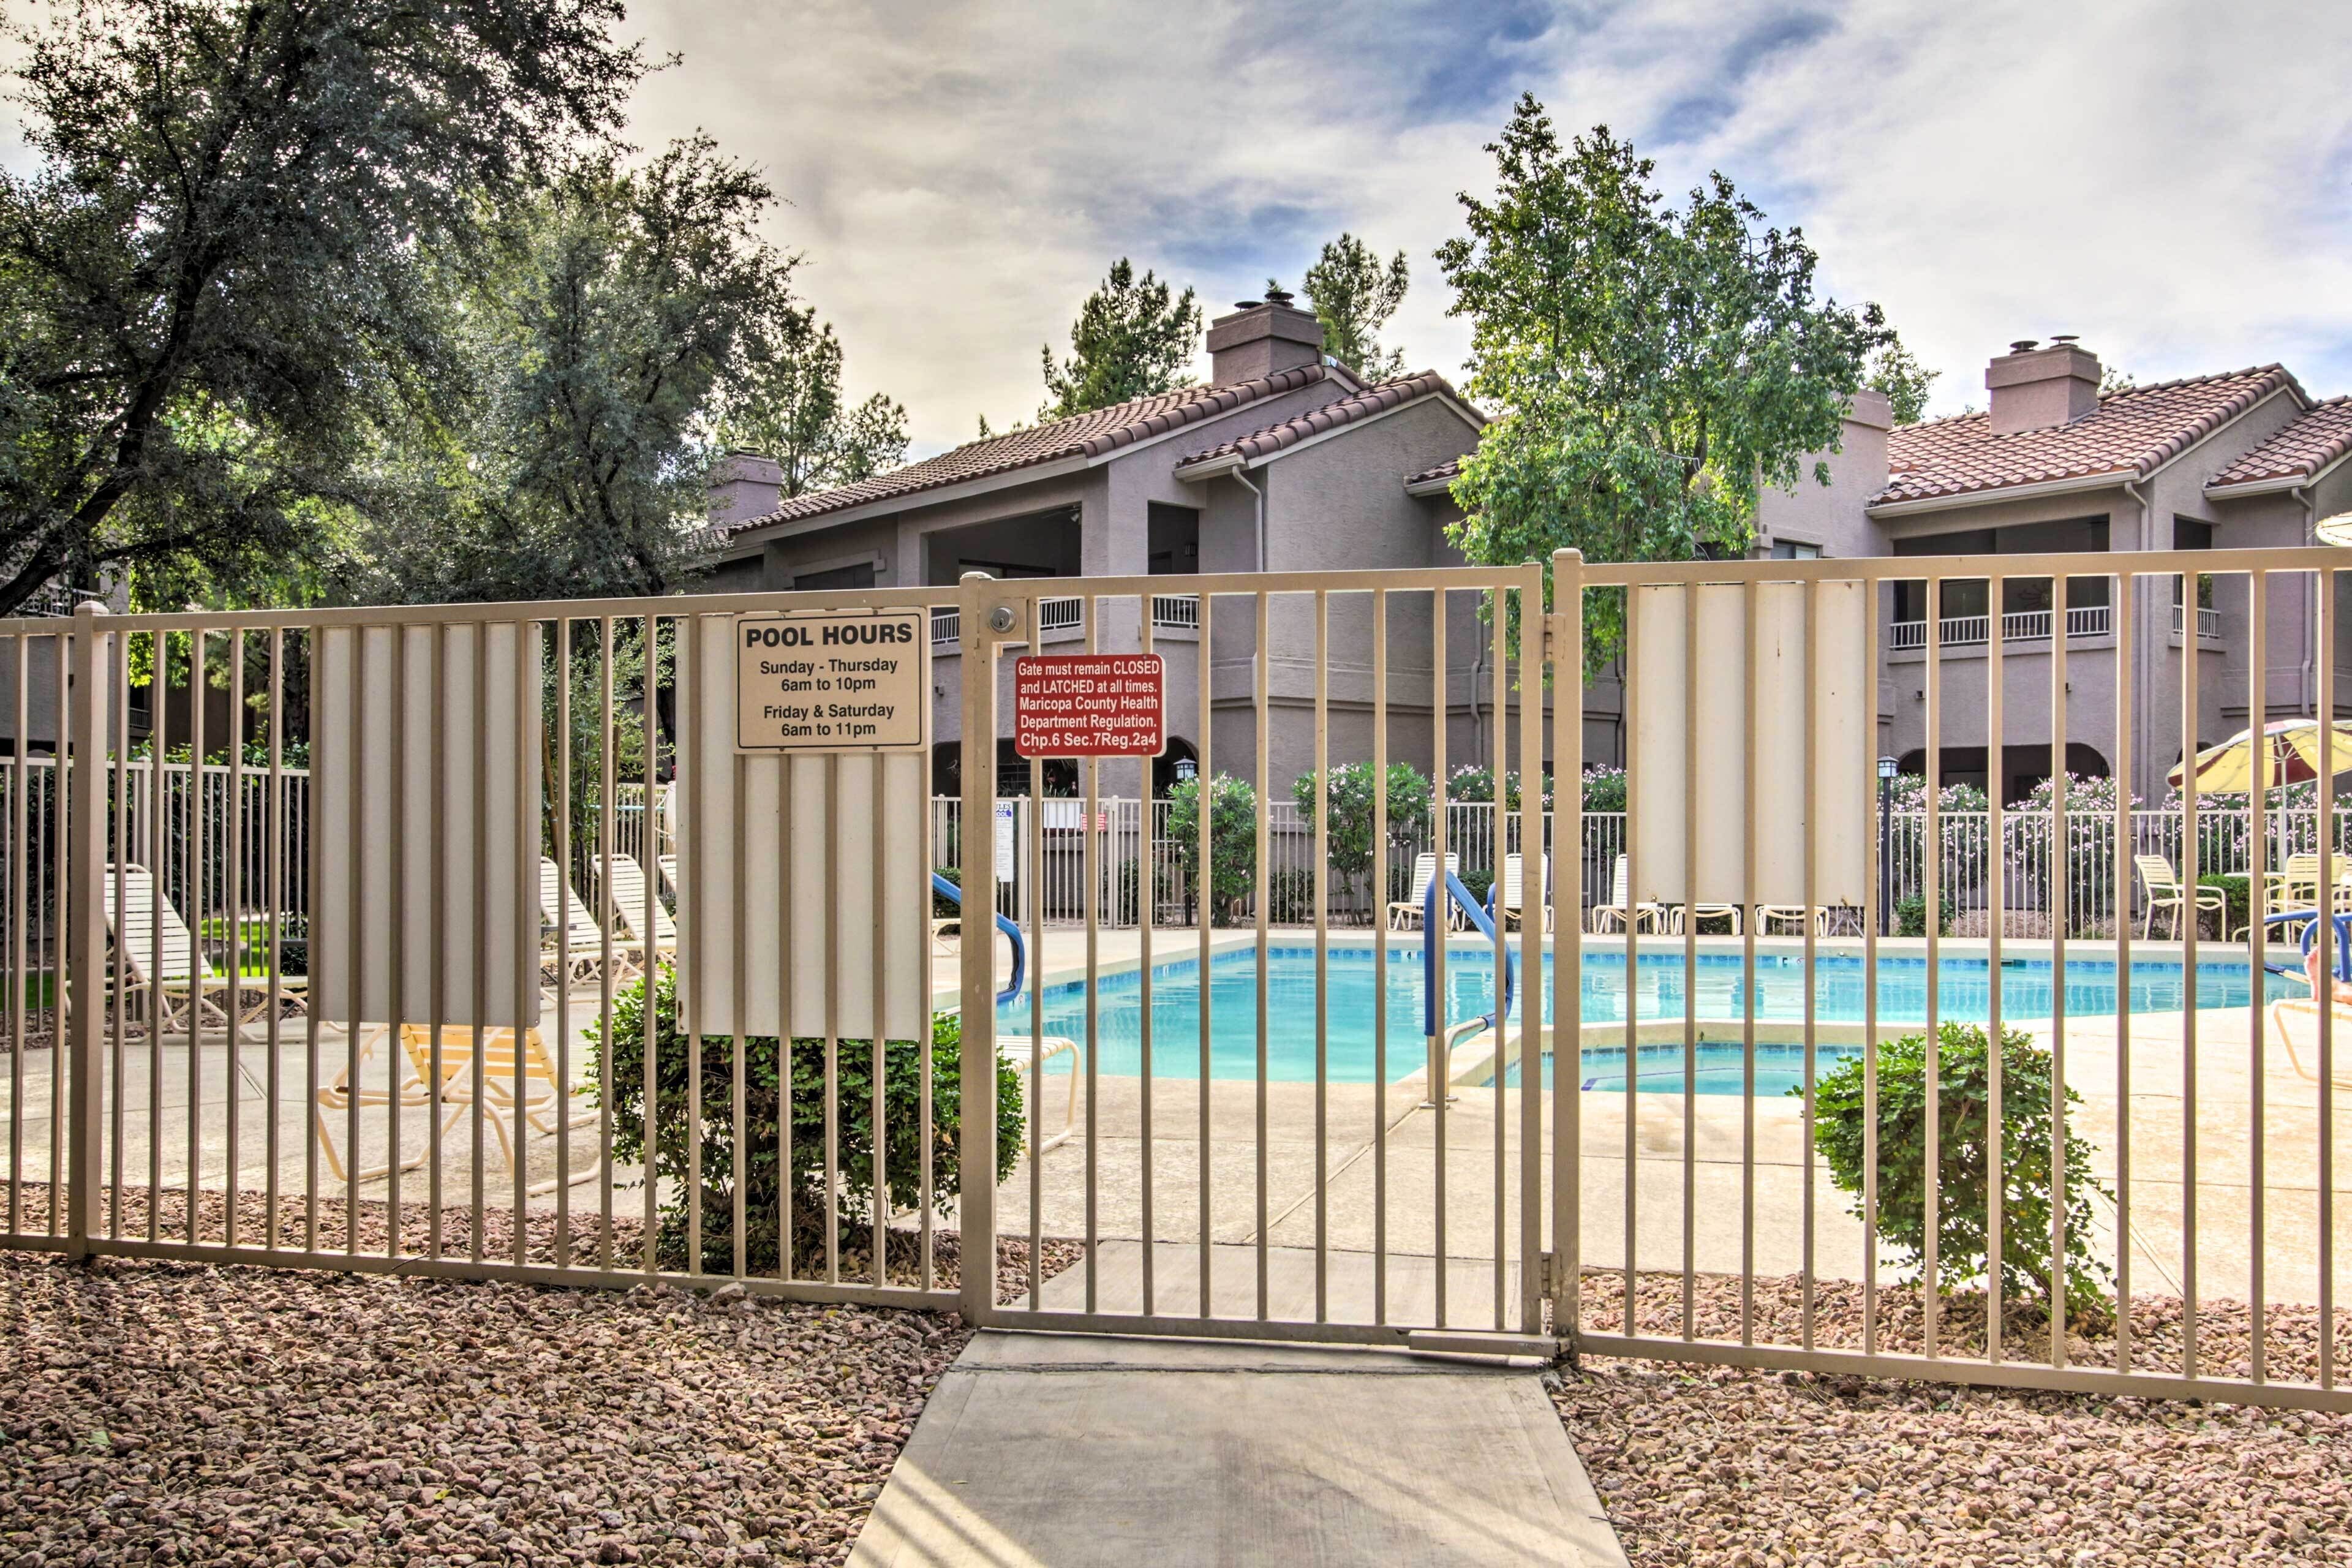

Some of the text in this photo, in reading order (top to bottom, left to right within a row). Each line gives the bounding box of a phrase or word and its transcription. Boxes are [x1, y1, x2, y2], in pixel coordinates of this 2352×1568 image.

[746, 623, 913, 648] POOL HOURS
[760, 660, 815, 677] Sunday
[828, 657, 898, 674] Thursday
[1018, 660, 1159, 676] Gate must remain CLOSED
[781, 677, 876, 693] 6am to 10pm
[1020, 679, 1157, 694] and LATCHED at all times.
[764, 703, 895, 722] Friday & Saturday
[1019, 695, 1158, 714] Maricopa County Health
[781, 722, 876, 739] 6am to 11pm
[1020, 714, 1157, 731] Department Regulation.
[1020, 733, 1060, 751] Chp.6
